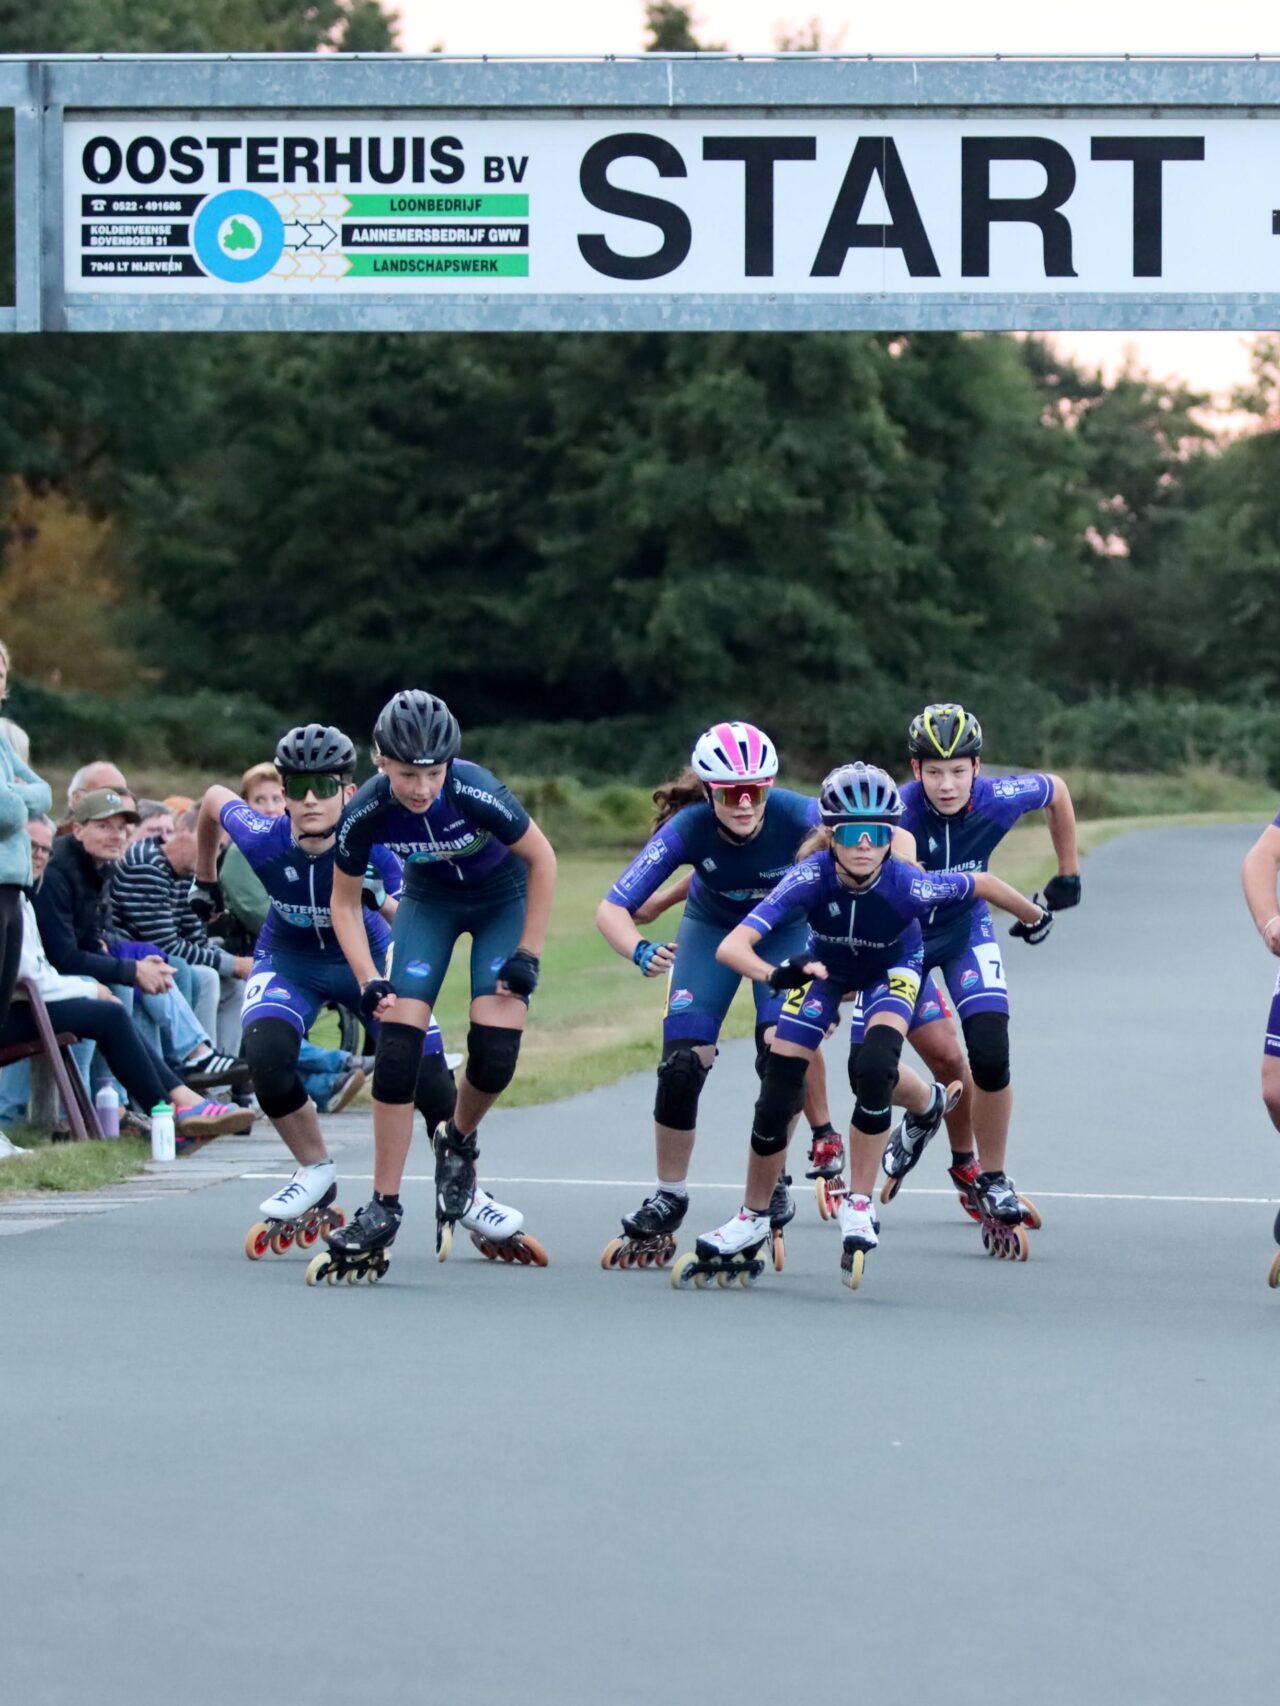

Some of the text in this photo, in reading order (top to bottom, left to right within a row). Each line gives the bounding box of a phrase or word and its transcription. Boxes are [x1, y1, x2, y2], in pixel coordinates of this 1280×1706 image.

[82, 135, 529, 185] OOSTERHUIS BV
[112, 201, 138, 211] 0522
[389, 198, 483, 213] LOONBEDRIJF
[576, 132, 1205, 281] START
[90, 225, 172, 235] KOLDERVEENSE
[351, 227, 522, 243] AANNEMERSBEDRIJF GWW
[90, 236, 168, 246] BOVENBOER 31
[116, 261, 129, 272] LT
[131, 261, 183, 272] NIJEVEEN
[372, 258, 499, 274] LANDSCHAPSWERK
